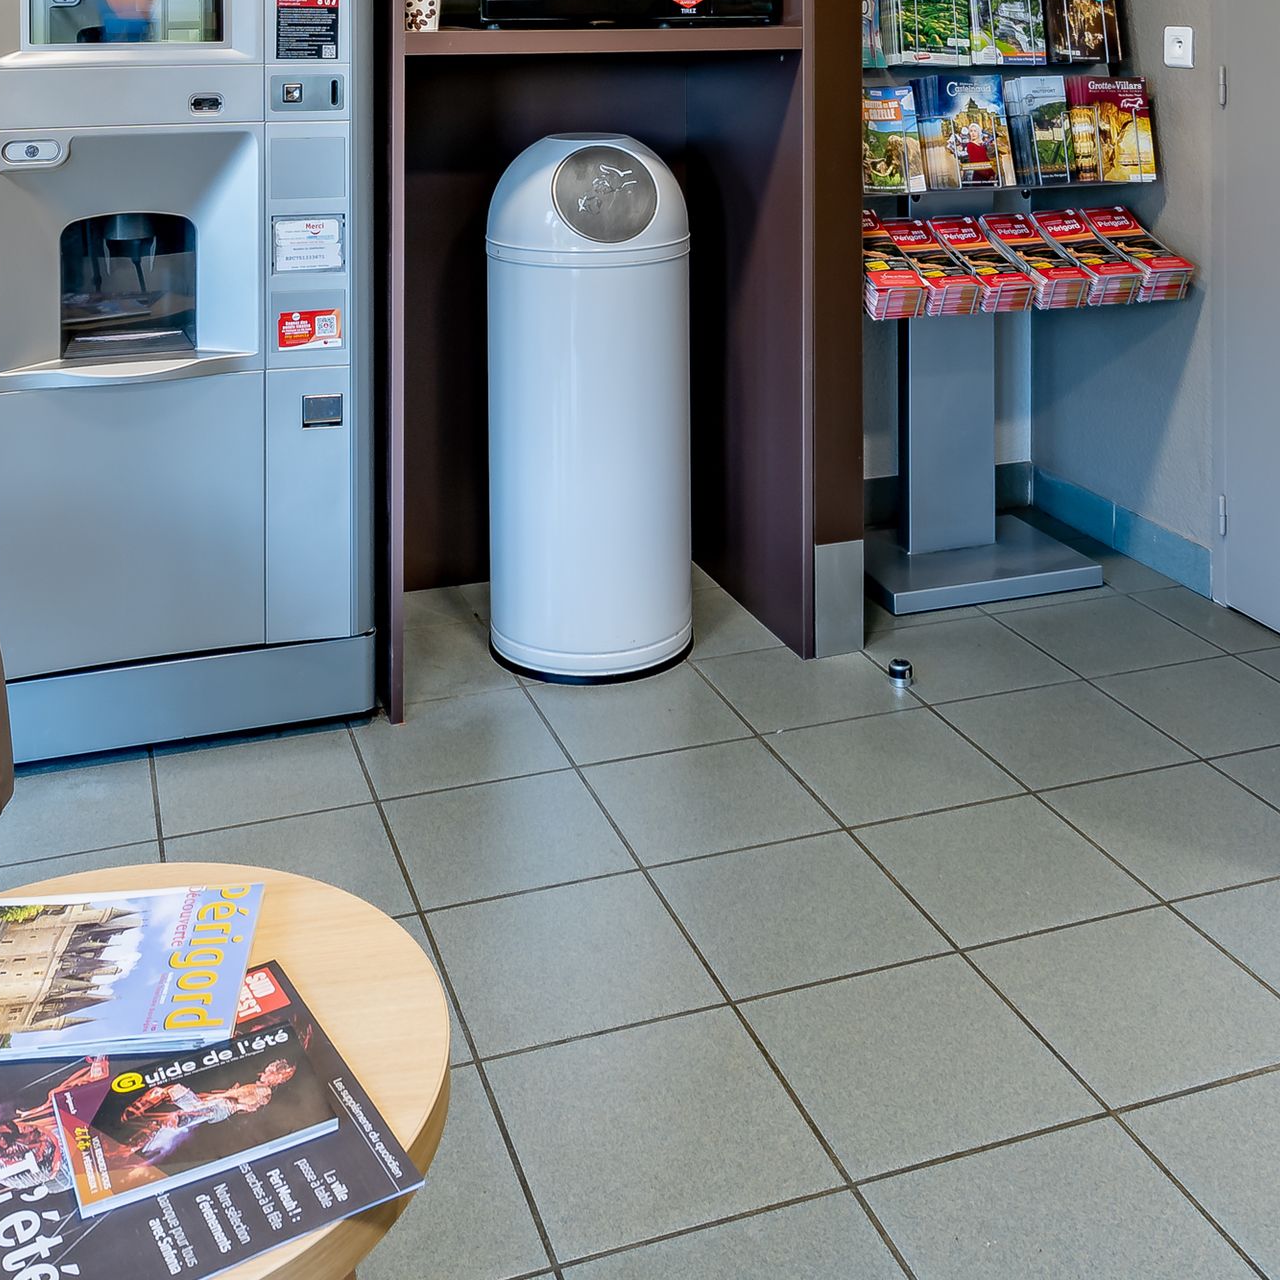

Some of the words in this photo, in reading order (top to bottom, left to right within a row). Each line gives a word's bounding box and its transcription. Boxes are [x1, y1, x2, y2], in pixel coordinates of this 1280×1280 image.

[1088, 81, 1112, 90] Grotte
[1116, 80, 1142, 90] Villars
[943, 230, 977, 242] Périgord
[164, 885, 251, 1030] Périgord
[246, 972, 276, 998] SUD
[111, 1060, 197, 1094] Guide
[203, 1049, 234, 1065] de
[237, 1031, 289, 1054] l'été
